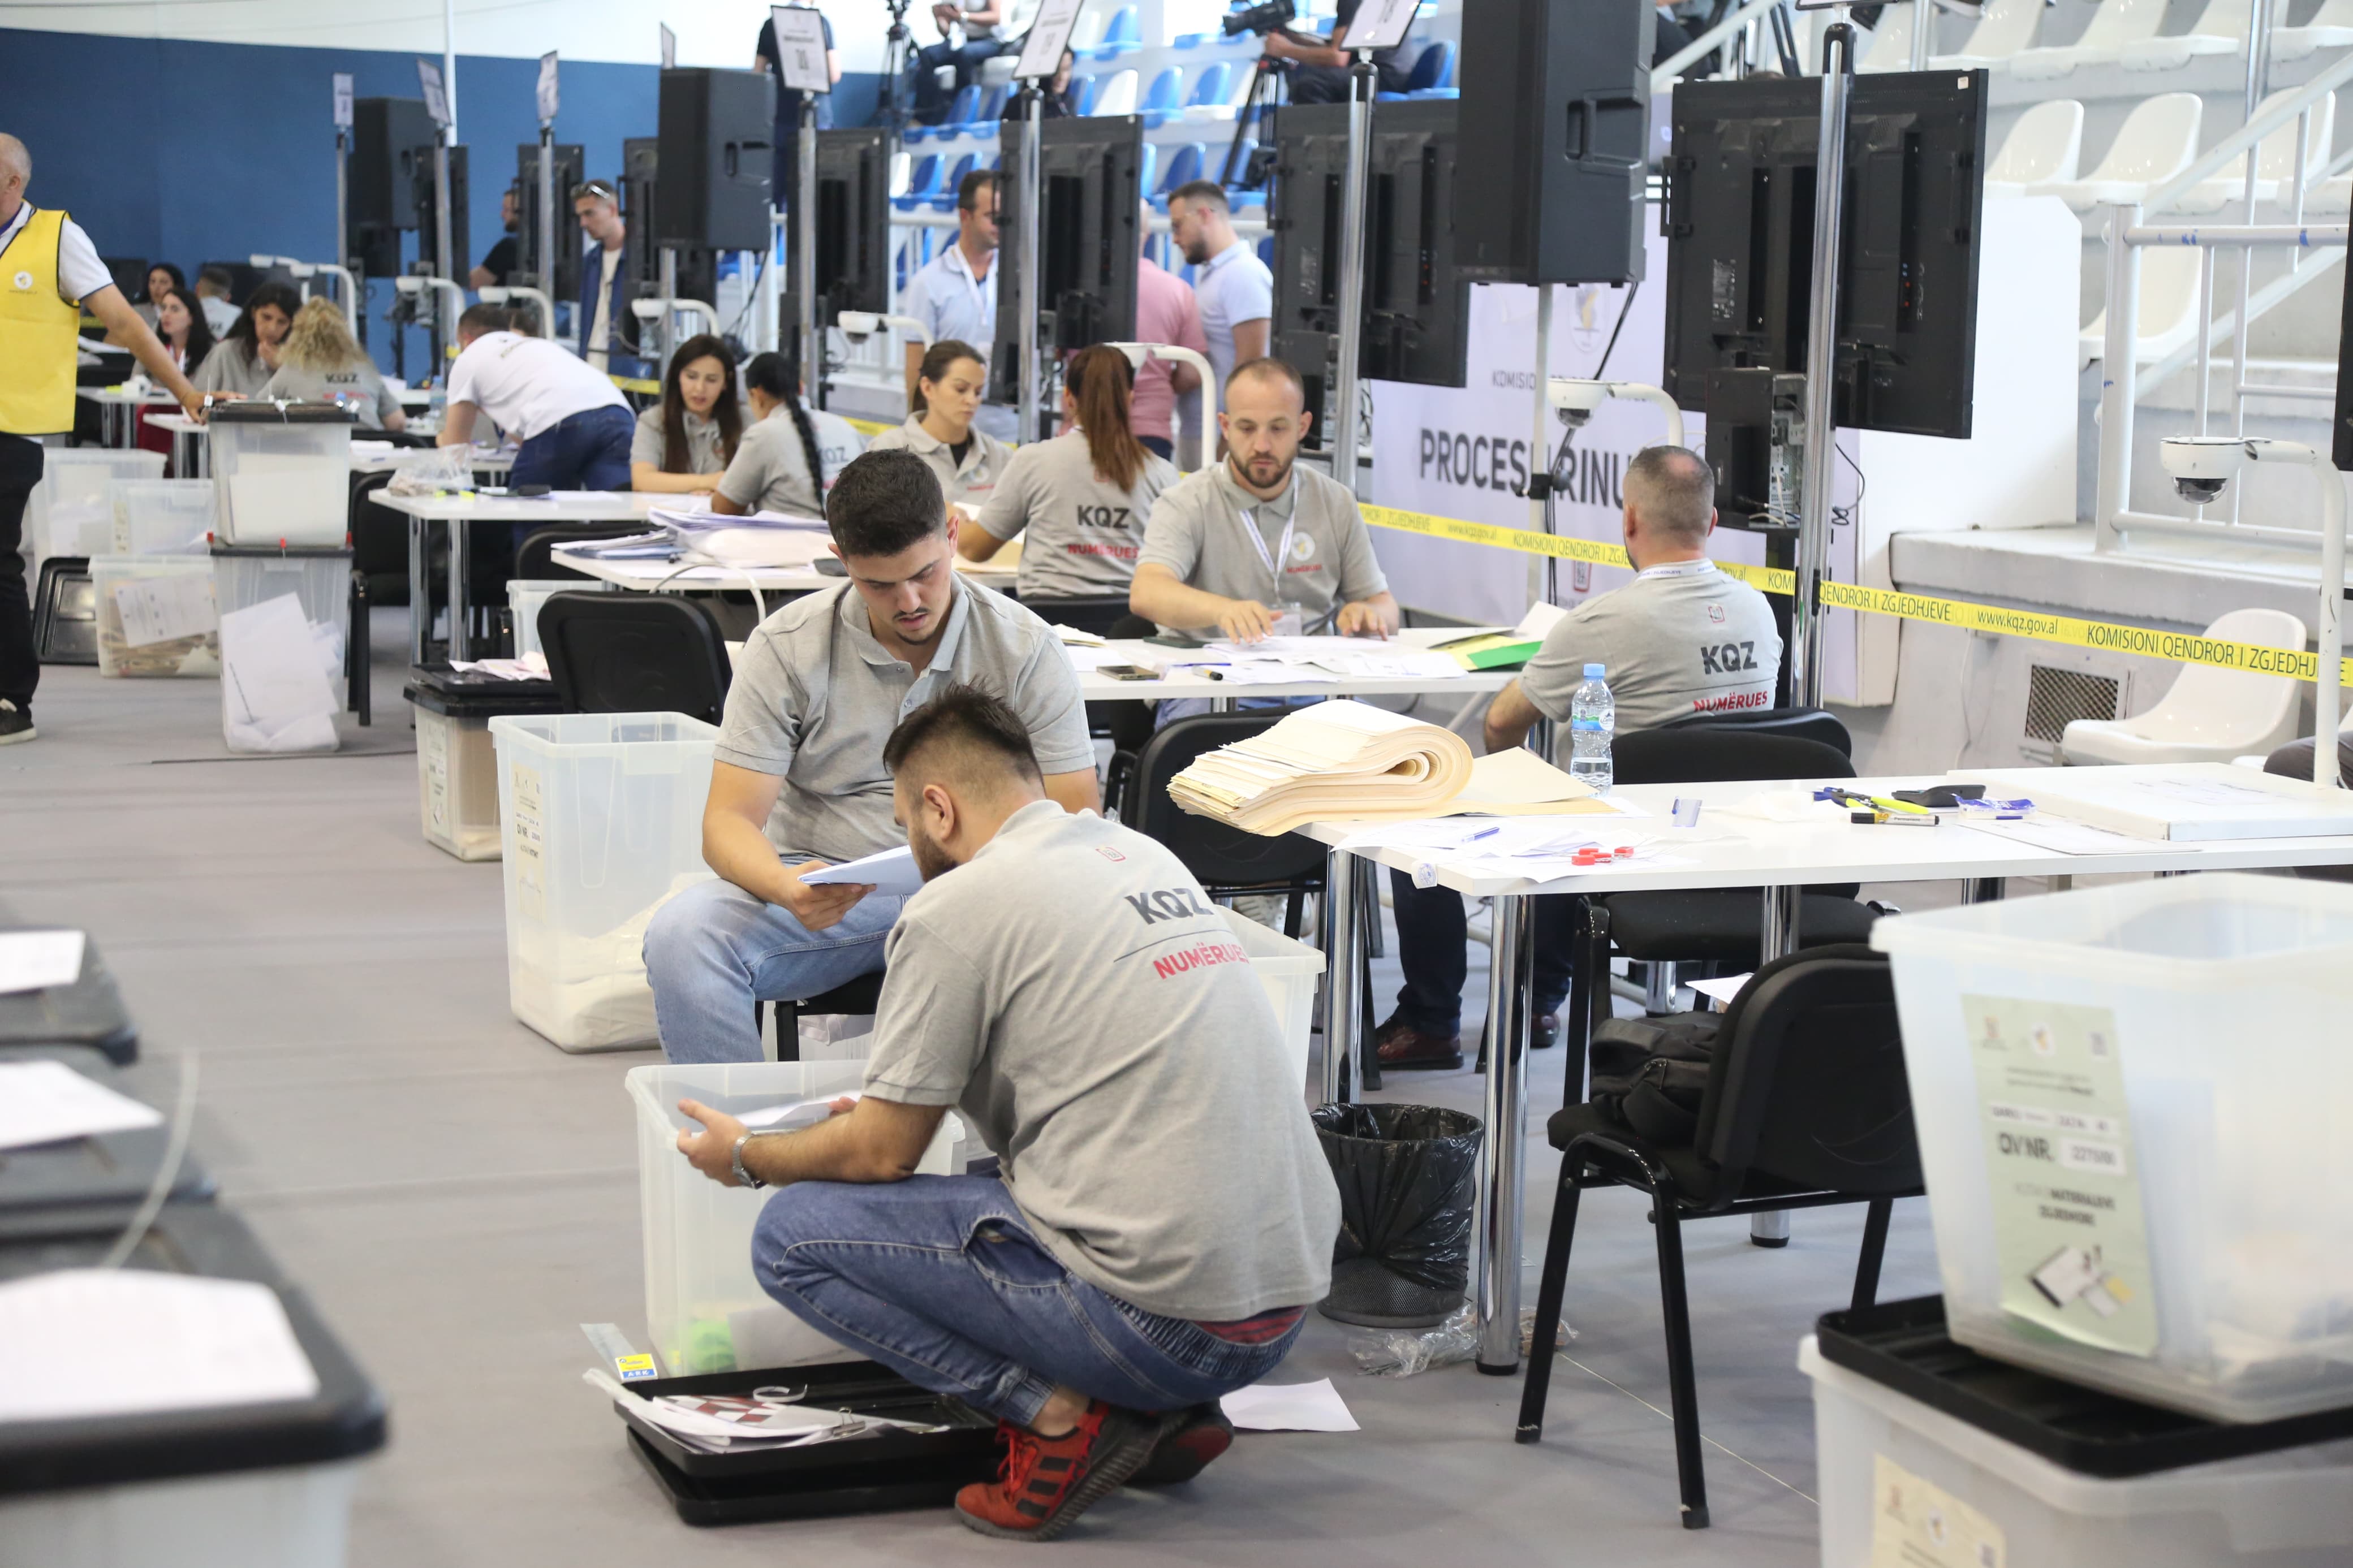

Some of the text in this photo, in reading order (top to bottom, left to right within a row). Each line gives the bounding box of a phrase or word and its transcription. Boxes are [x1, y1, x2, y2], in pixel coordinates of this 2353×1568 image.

[1077, 504, 1130, 529] KQZ
[1514, 533, 1555, 552] KOMISIONI
[1558, 541, 1601, 561] QENDROR
[1820, 583, 1871, 608] QENDROR
[1881, 594, 1951, 621] ZGJEDHJEVE
[1977, 611, 2058, 635] www.kqz.gov.al
[2087, 624, 2159, 654] KOMISIONI
[2163, 636, 2234, 665] QENDROR
[2240, 646, 2244, 666] I
[1700, 641, 1758, 675] KQZ
[1693, 691, 1768, 712] NUMËRUES
[1124, 888, 1214, 925] KQZ
